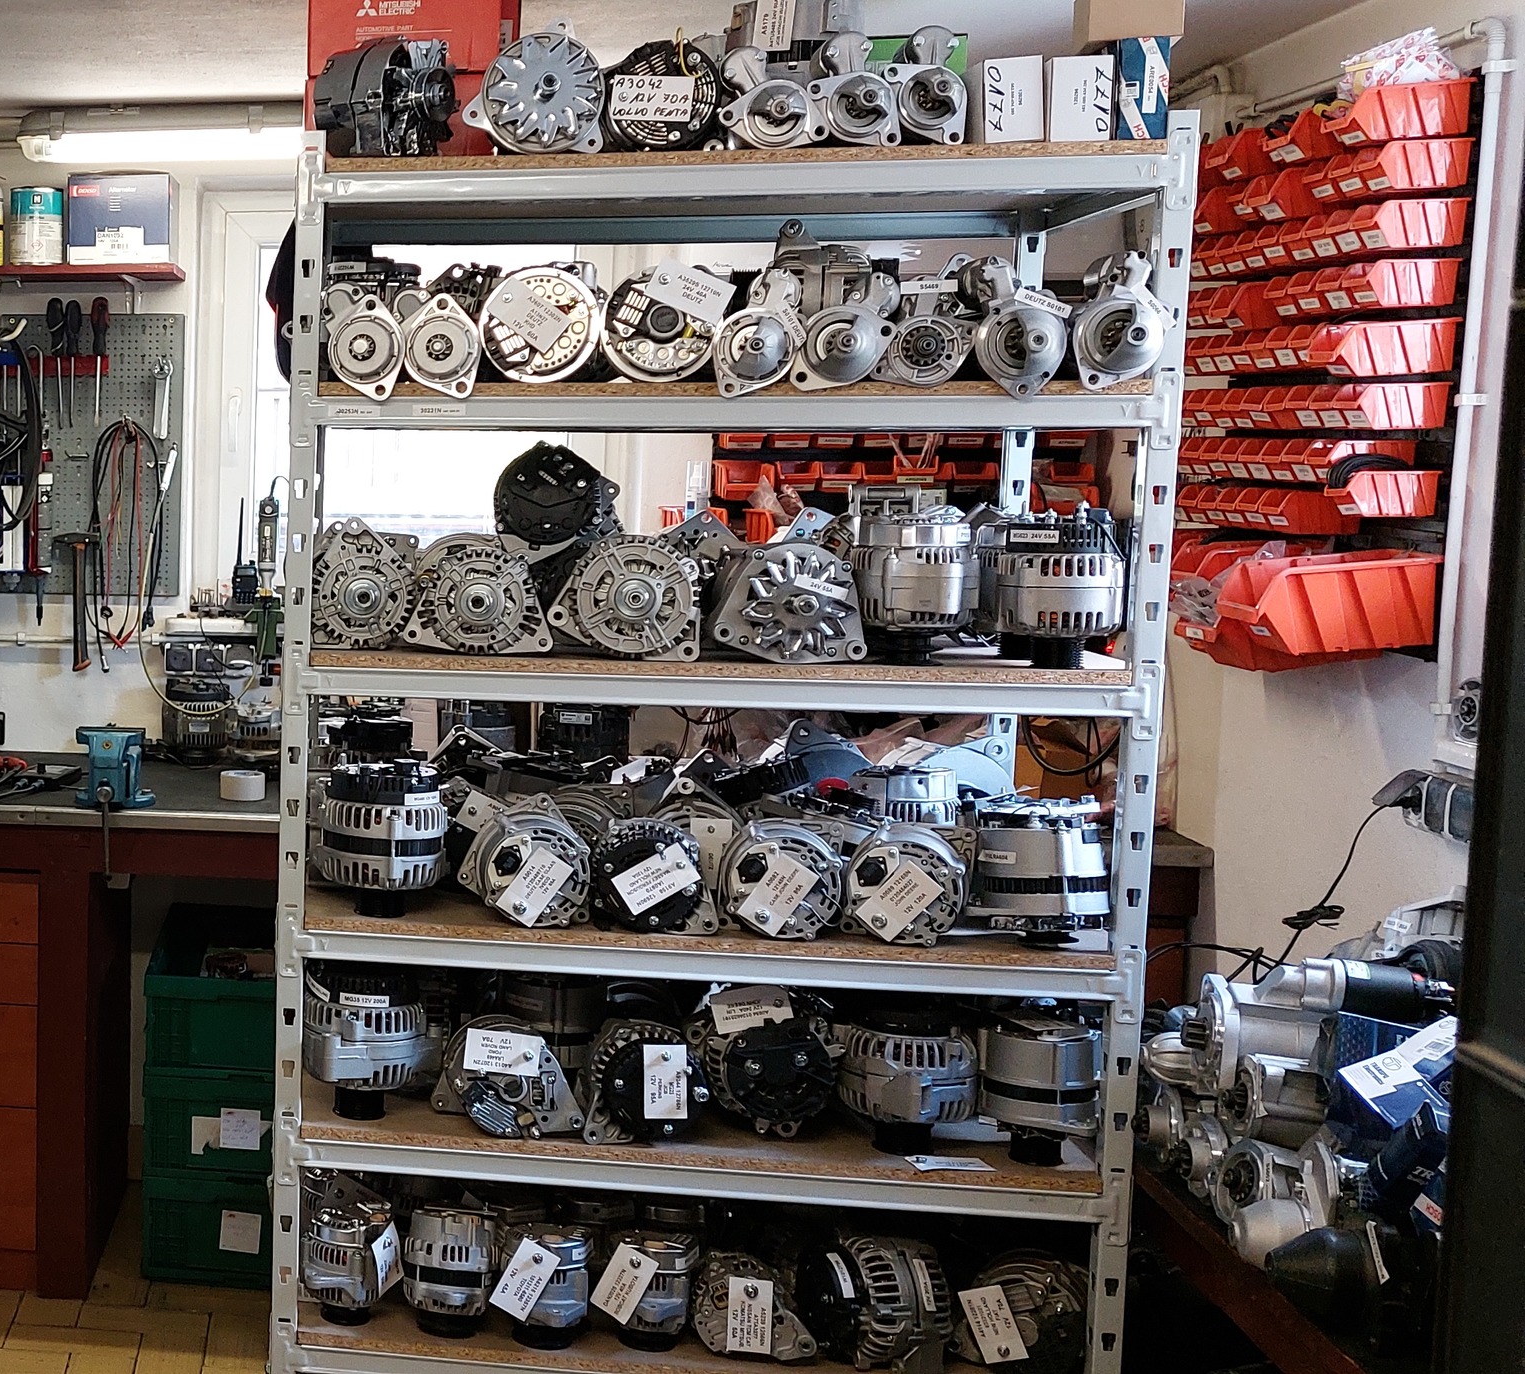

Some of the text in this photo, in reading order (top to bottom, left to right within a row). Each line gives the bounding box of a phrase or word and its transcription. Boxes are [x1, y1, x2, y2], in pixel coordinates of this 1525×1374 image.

[379, 0, 421, 8] MITSUBISHI
[379, 7, 415, 15] ELECTRIC
[616, 78, 663, 89] A3042
[630, 93, 689, 104] 12V 70A
[612, 107, 689, 117] VOLVO PENTA
[682, 284, 695, 294] 24V
[681, 291, 703, 305] DEUTZ
[1024, 293, 1046, 305] DEUTZ
[511, 319, 525, 332] 12V
[525, 312, 543, 327] DEUTZ
[792, 325, 805, 343] DEUT
[810, 582, 833, 593] 24V 55A
[784, 894, 796, 906] 12V
[892, 881, 920, 908] JOHN DEERE
[902, 903, 916, 916] 12V
[508, 1266, 519, 1279] 12V
[512, 1277, 528, 1298] TOYOTA
[612, 1274, 640, 1316] BOBCAT KUBOTA
[979, 1296, 1000, 1336] NEW HOLLAND
[992, 1308, 1001, 1321] FIAT
[1002, 1316, 1013, 1330] 12V
